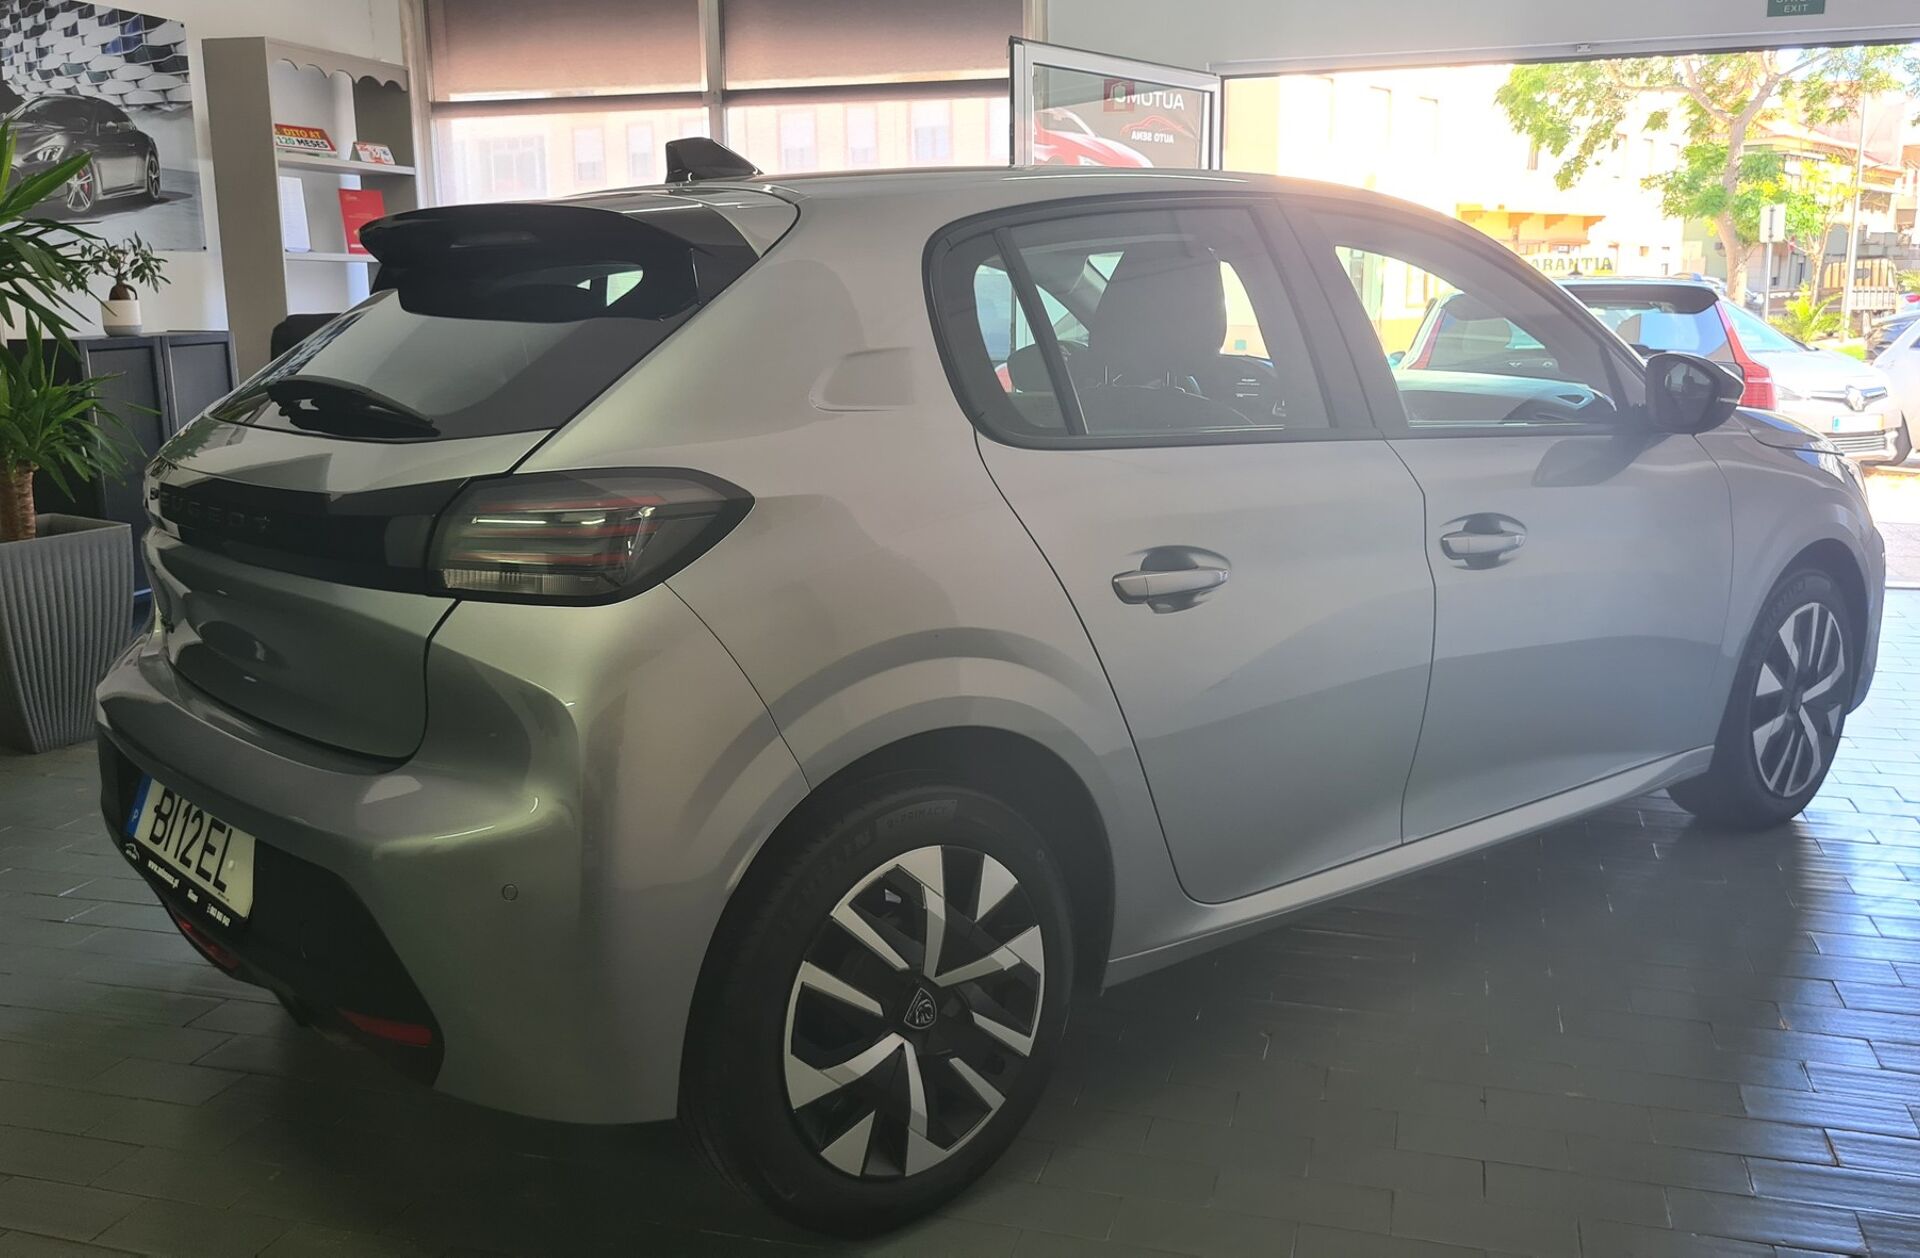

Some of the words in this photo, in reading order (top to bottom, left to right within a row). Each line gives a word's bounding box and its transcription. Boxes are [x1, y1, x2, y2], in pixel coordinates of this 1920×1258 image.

[1784, 4, 1808, 13] EXIT
[296, 138, 329, 148] MESES
[1531, 257, 1613, 270] ARANTIA
